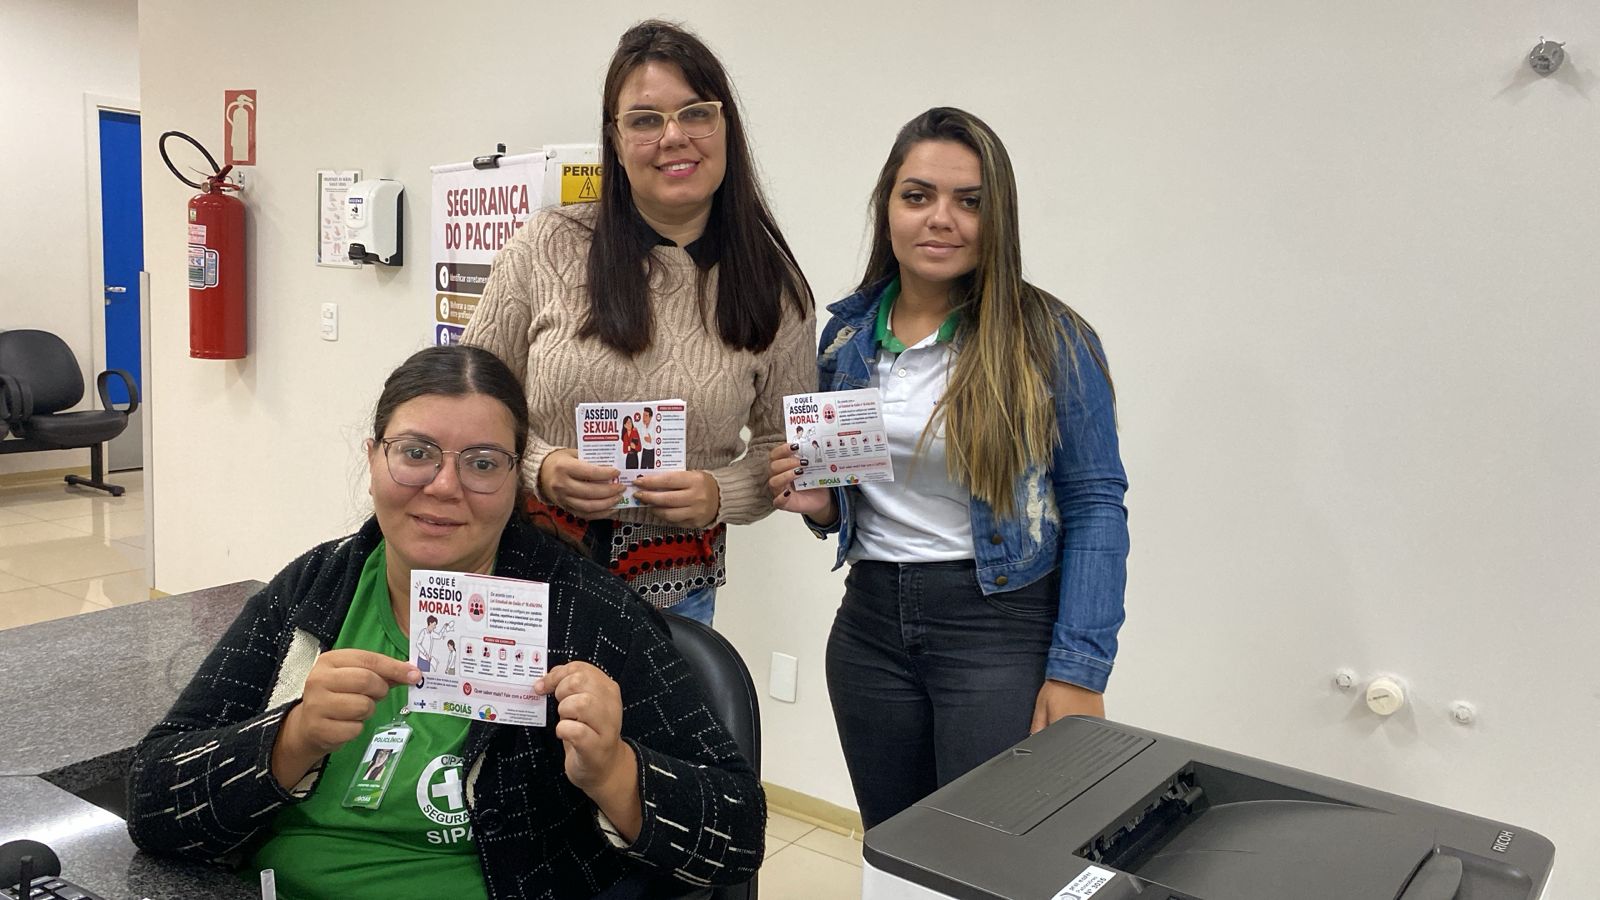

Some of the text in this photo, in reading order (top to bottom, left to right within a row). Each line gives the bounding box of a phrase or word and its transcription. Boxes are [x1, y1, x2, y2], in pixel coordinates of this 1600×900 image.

[447, 184, 530, 223] SEGURANÇA
[446, 222, 461, 250] DO
[443, 272, 446, 284] 1
[443, 303, 447, 315] 2
[443, 333, 448, 347] 3
[585, 406, 618, 420] ASSÉDIO
[790, 404, 818, 415] ASSÉDIO
[790, 414, 819, 425] MORAL?
[583, 421, 619, 433] SEXUAL
[429, 576, 455, 587] O QUE É
[419, 586, 462, 602] ASSÉDIO
[419, 600, 462, 616] MORAL?
[449, 702, 471, 714] GOIÁS
[423, 804, 470, 824] SEGURA
[1493, 830, 1515, 853] RICOH
